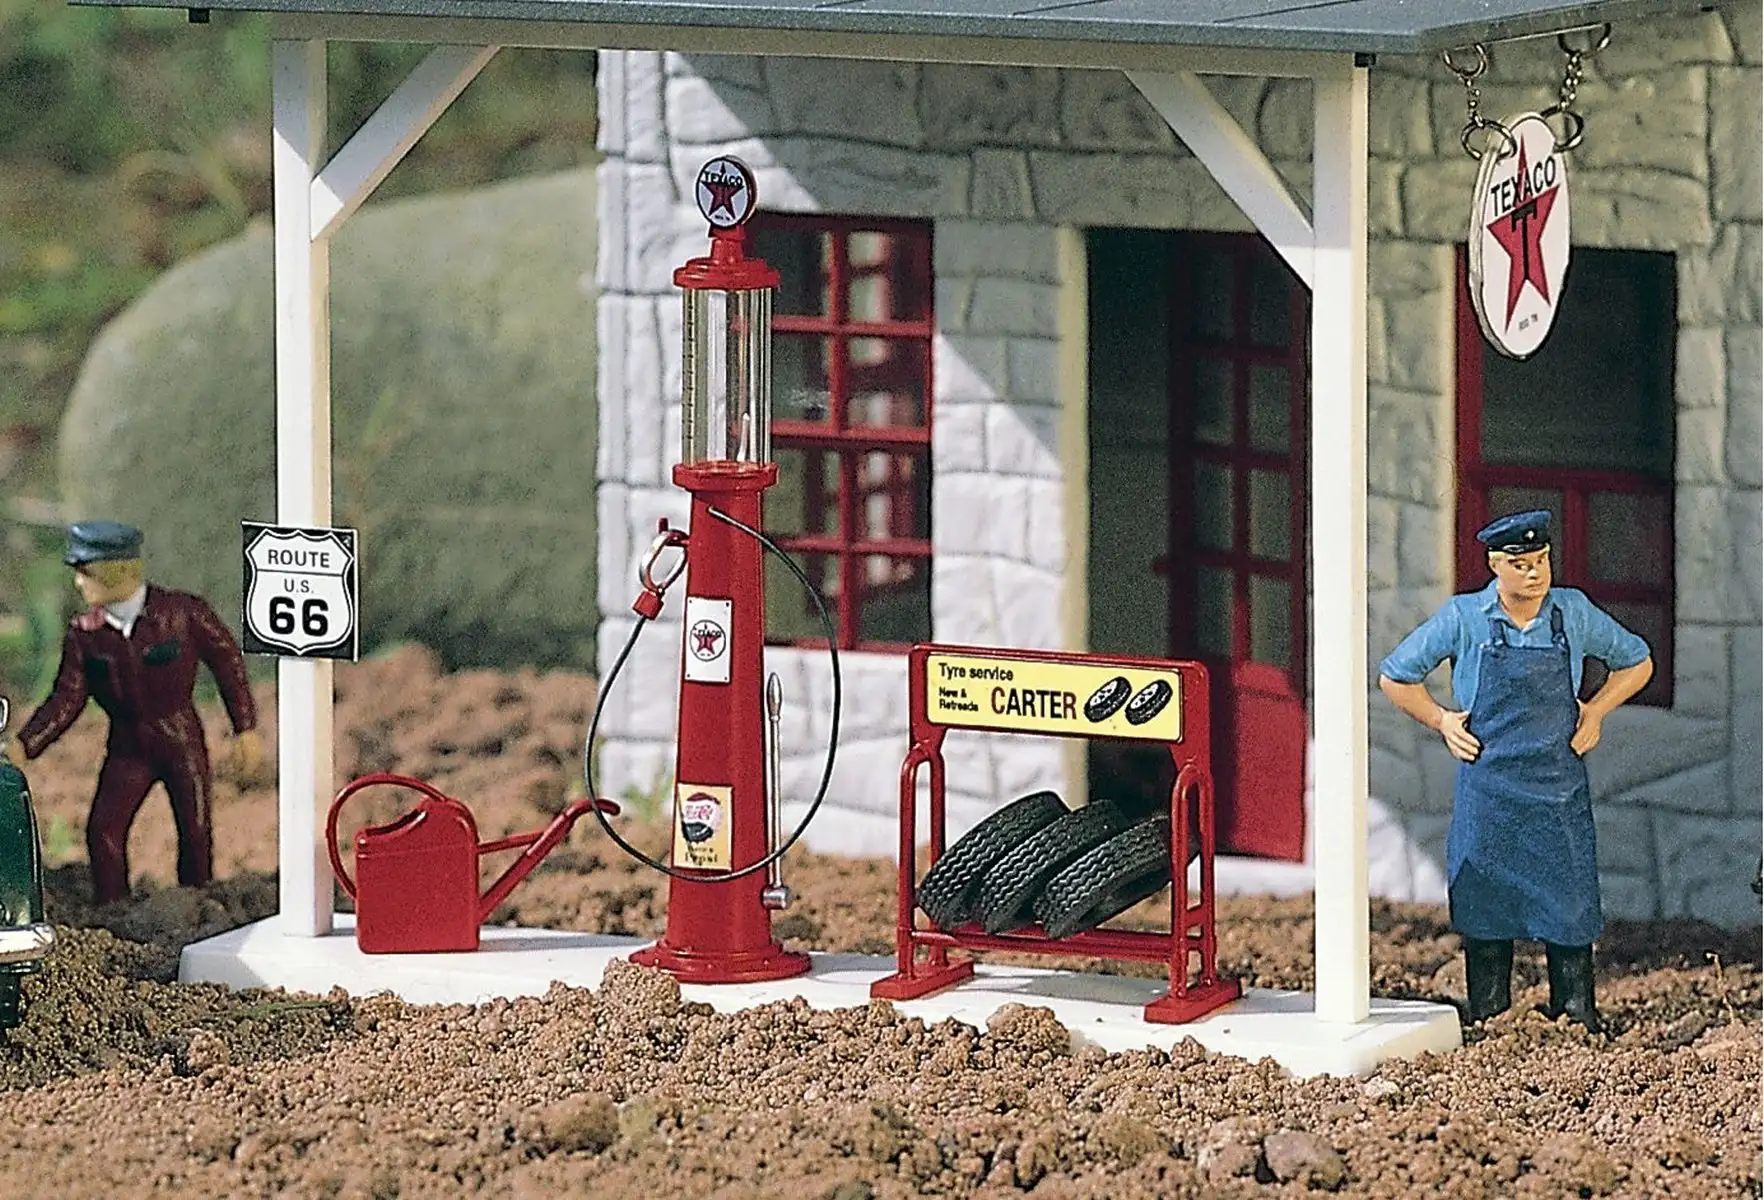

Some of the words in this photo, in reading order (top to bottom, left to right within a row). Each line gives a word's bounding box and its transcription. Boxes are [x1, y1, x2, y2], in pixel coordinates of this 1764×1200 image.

[1490, 155, 1556, 217] TEXACO
[268, 549, 330, 568] ROUTE
[284, 579, 314, 594] U.S.
[269, 596, 329, 637] 66
[938, 662, 966, 680] Tyre
[969, 666, 1014, 681] service
[939, 687, 958, 698] New
[961, 688, 967, 698] &
[939, 699, 979, 712] Retreads
[991, 686, 1077, 720] CARTER
